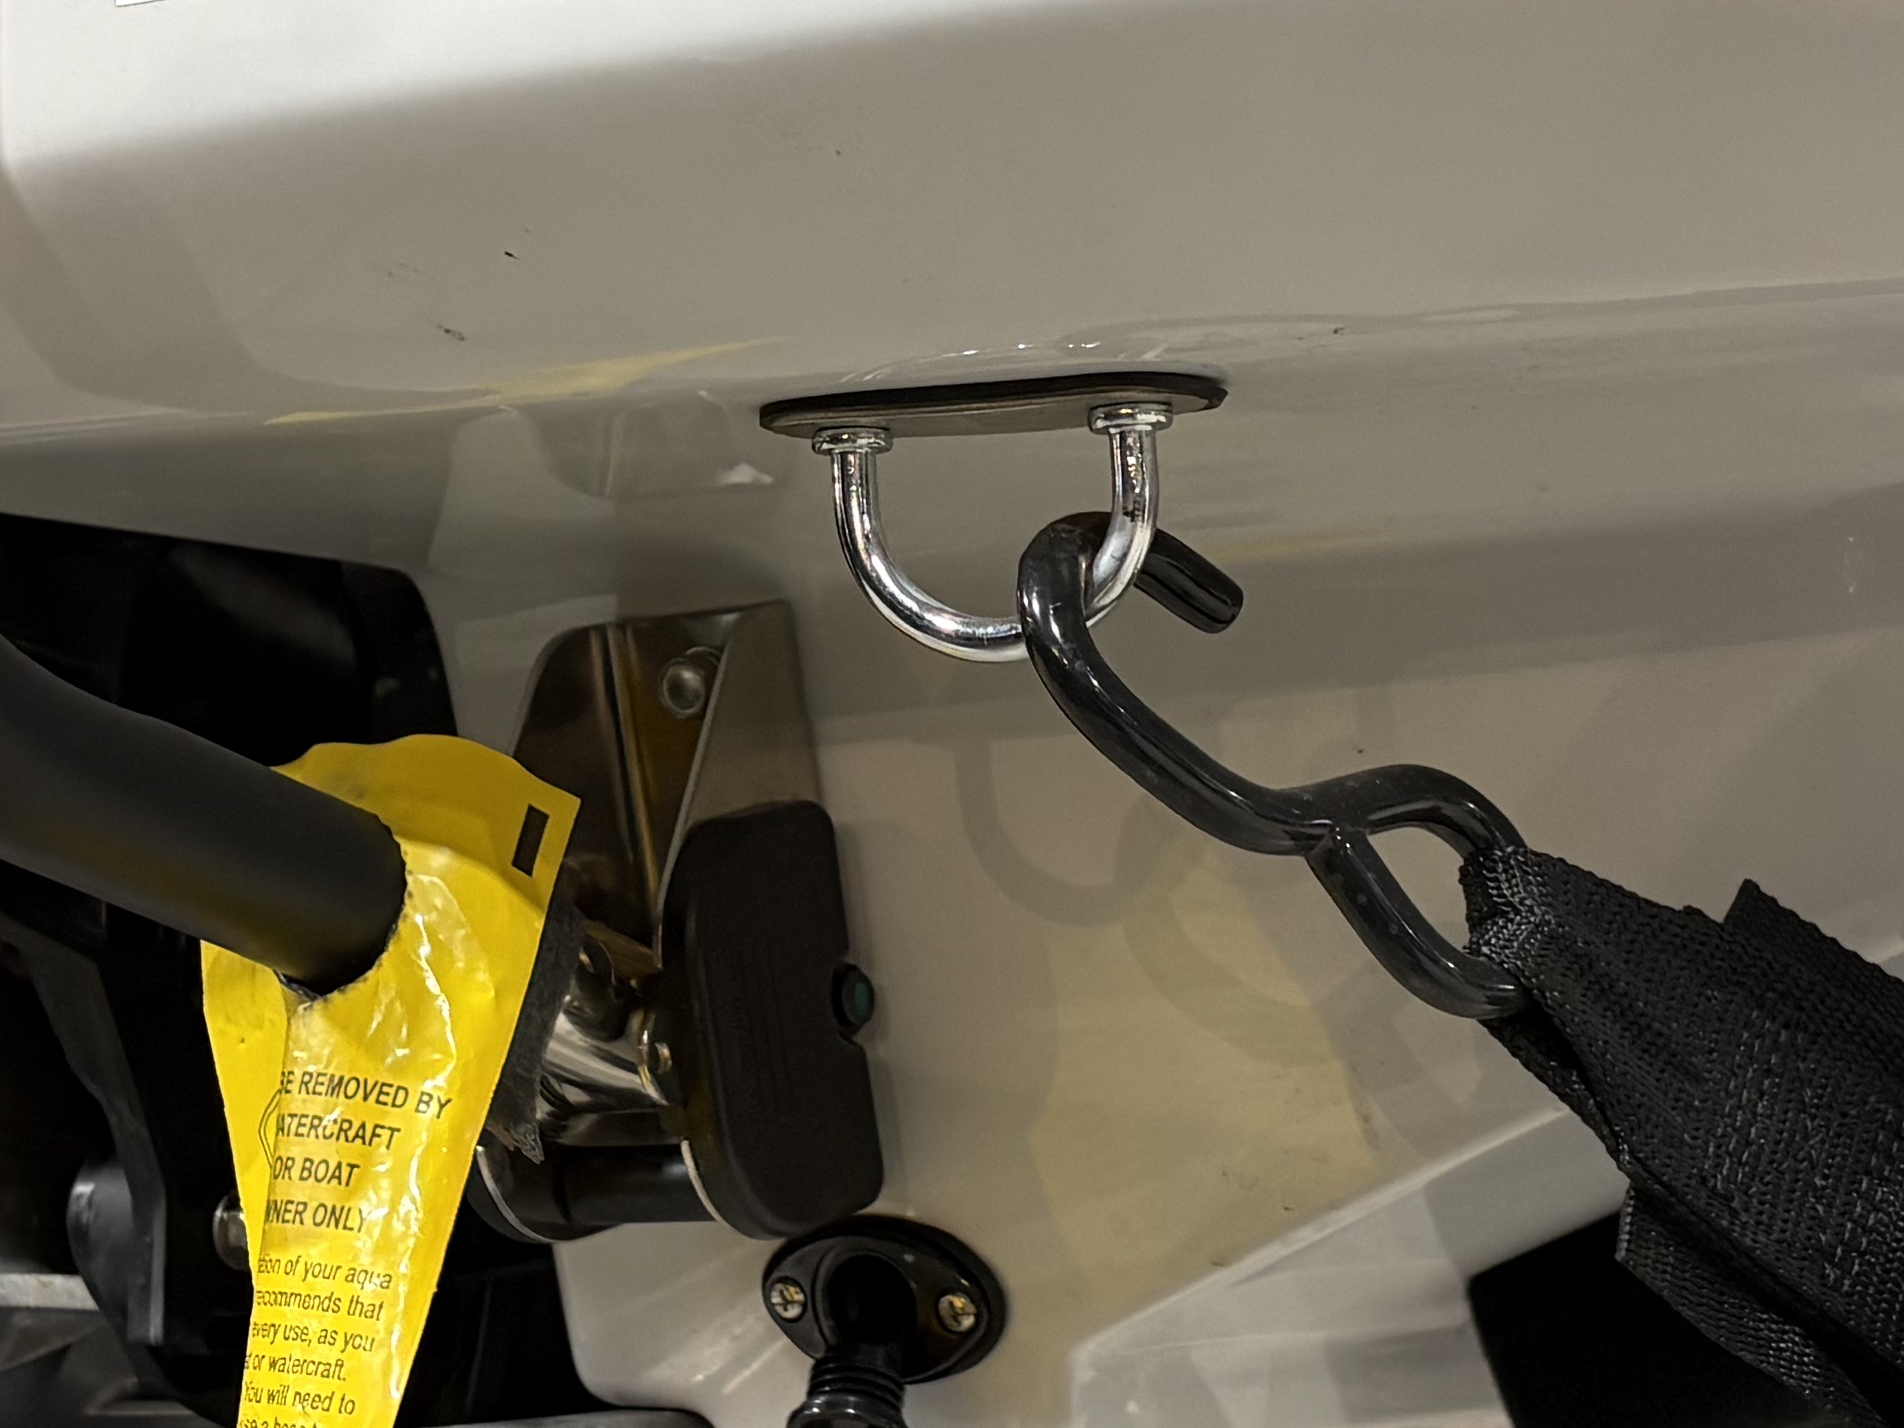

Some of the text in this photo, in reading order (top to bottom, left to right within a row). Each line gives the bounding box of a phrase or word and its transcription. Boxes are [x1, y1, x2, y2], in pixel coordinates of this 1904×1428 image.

[298, 1071, 409, 1109] REMOVED
[414, 1090, 453, 1119] BY
[276, 1112, 401, 1151] ATERCRAFT
[273, 1154, 361, 1187] OR BOAT
[312, 1202, 368, 1232] ONLY
[284, 1255, 302, 1276] of
[302, 1260, 343, 1283] your
[345, 1266, 393, 1290] aqua
[347, 1294, 384, 1322] that
[283, 1323, 313, 1347] use,
[317, 1328, 338, 1347] as
[340, 1331, 375, 1353] you
[268, 1354, 347, 1381] watercraft.
[267, 1384, 290, 1407] will
[292, 1390, 335, 1413] need
[338, 1392, 356, 1415] to
